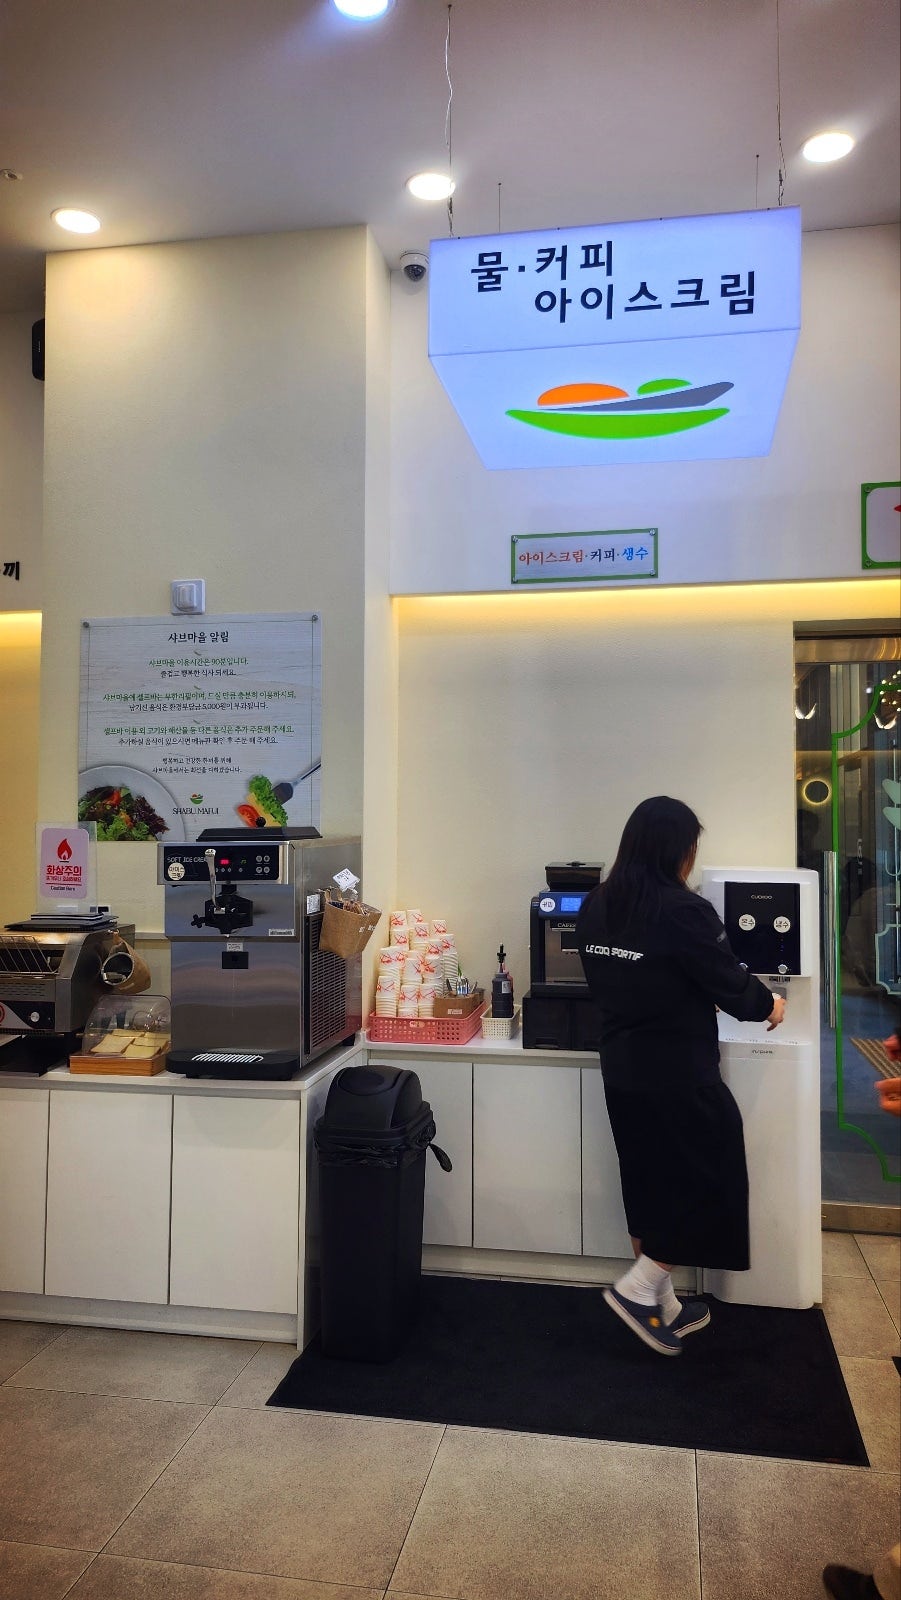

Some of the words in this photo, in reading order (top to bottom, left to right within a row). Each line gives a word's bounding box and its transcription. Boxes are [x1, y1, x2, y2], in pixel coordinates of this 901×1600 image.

[471, 240, 613, 293] 물·커피
[534, 271, 756, 324] 아이스크림
[0, 561, 20, 581] 끼
[168, 632, 207, 644] 샤브마을
[209, 630, 229, 643] 알림
[149, 659, 175, 668] 샤브마을
[176, 657, 211, 667] 이용시간은
[160, 670, 180, 679] 즐겁고
[181, 669, 200, 678] 행복한
[201, 668, 215, 677] 식사
[103, 693, 136, 702] 샤브마을에
[137, 692, 163, 701] 셀프바는
[222, 690, 236, 699] 만큼
[237, 690, 258, 699] 충분히
[129, 703, 148, 712] 남기신
[149, 703, 168, 711] 음식은
[104, 727, 124, 735] 셀프바
[147, 726, 168, 735] 고기와
[198, 726, 213, 735] 다른
[213, 725, 234, 735] 음식은
[234, 725, 249, 734] 추가
[145, 738, 164, 746] 음식이
[46, 865, 82, 876] 화상주의
[585, 944, 594, 954] LE
[594, 945, 610, 957] COQ
[611, 947, 644, 961] SPORTIF
